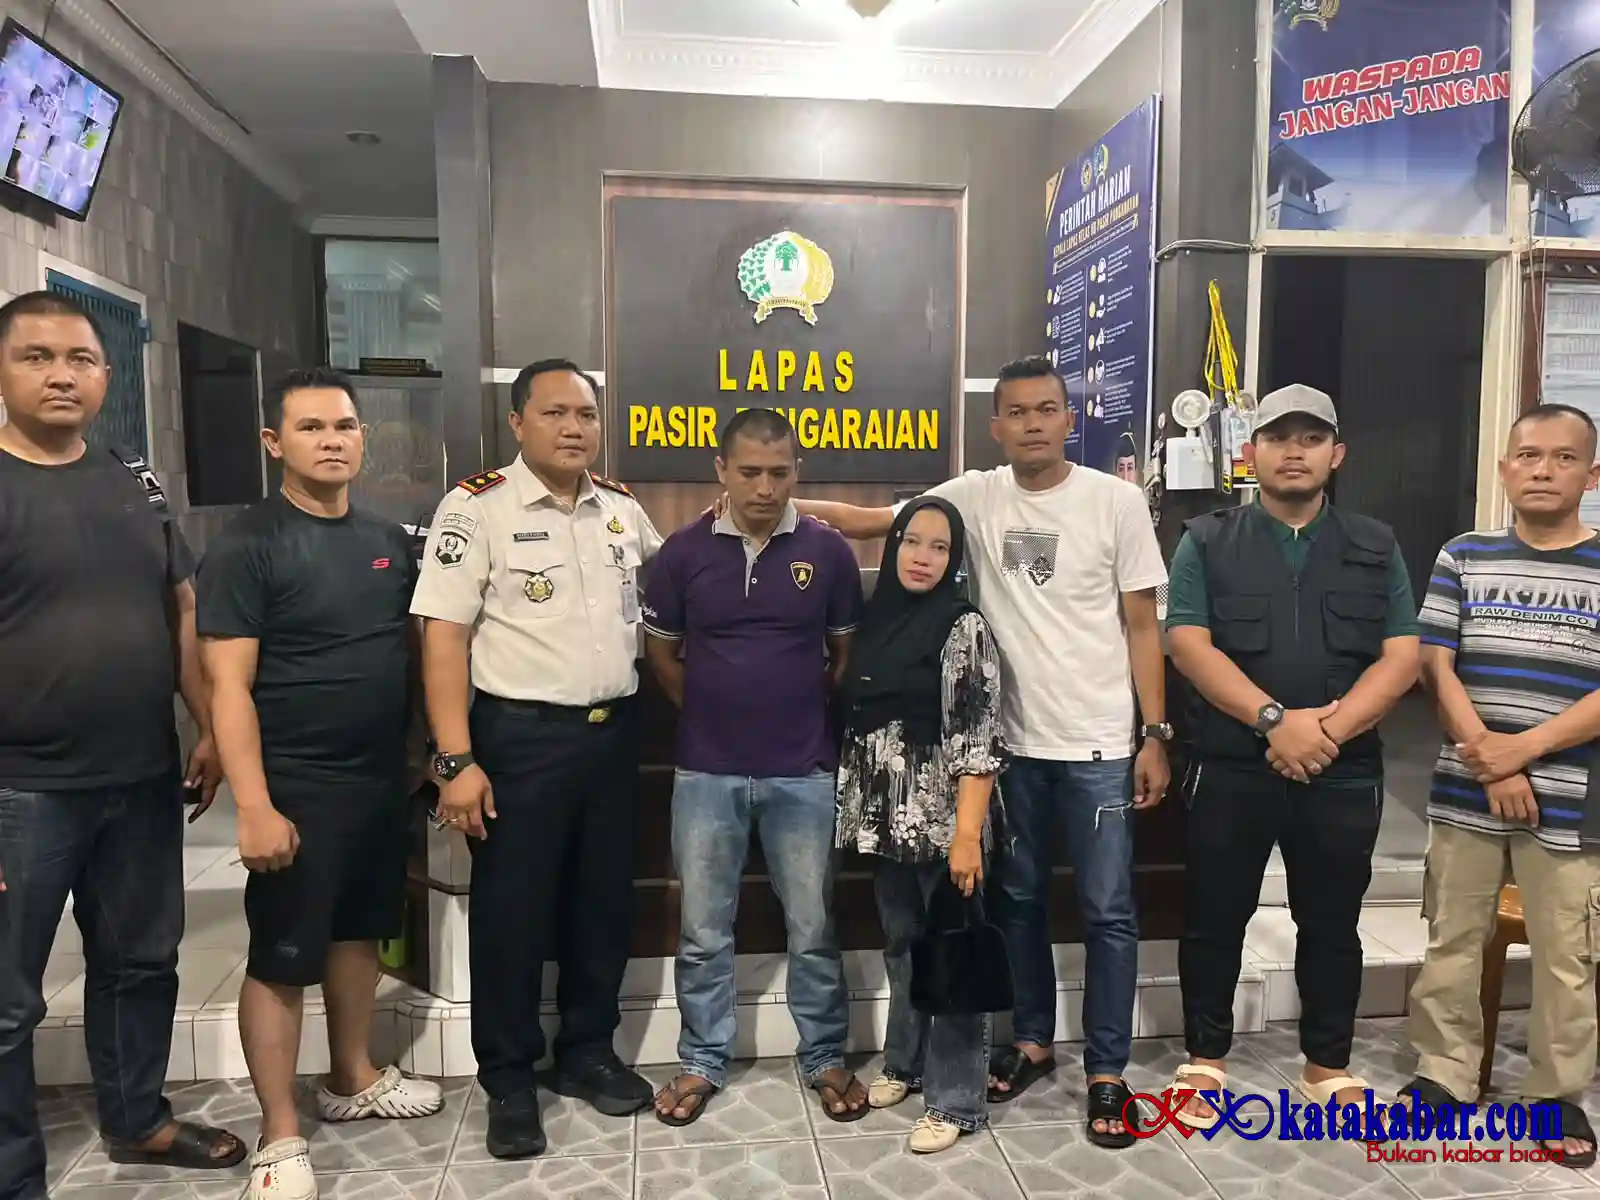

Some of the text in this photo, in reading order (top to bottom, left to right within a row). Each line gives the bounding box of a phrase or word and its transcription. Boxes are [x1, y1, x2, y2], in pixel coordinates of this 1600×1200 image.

[1303, 45, 1481, 104] WASPADA
[1279, 71, 1510, 139] JANGAN-JANGAN
[1060, 189, 1096, 238] PERINTAH
[1098, 164, 1131, 212] HARIAN
[719, 349, 854, 393] LAPAS
[629, 404, 939, 450] PASIR GARAIAN
[1475, 608, 1508, 616] RAW
[1511, 609, 1561, 621] DENIM
